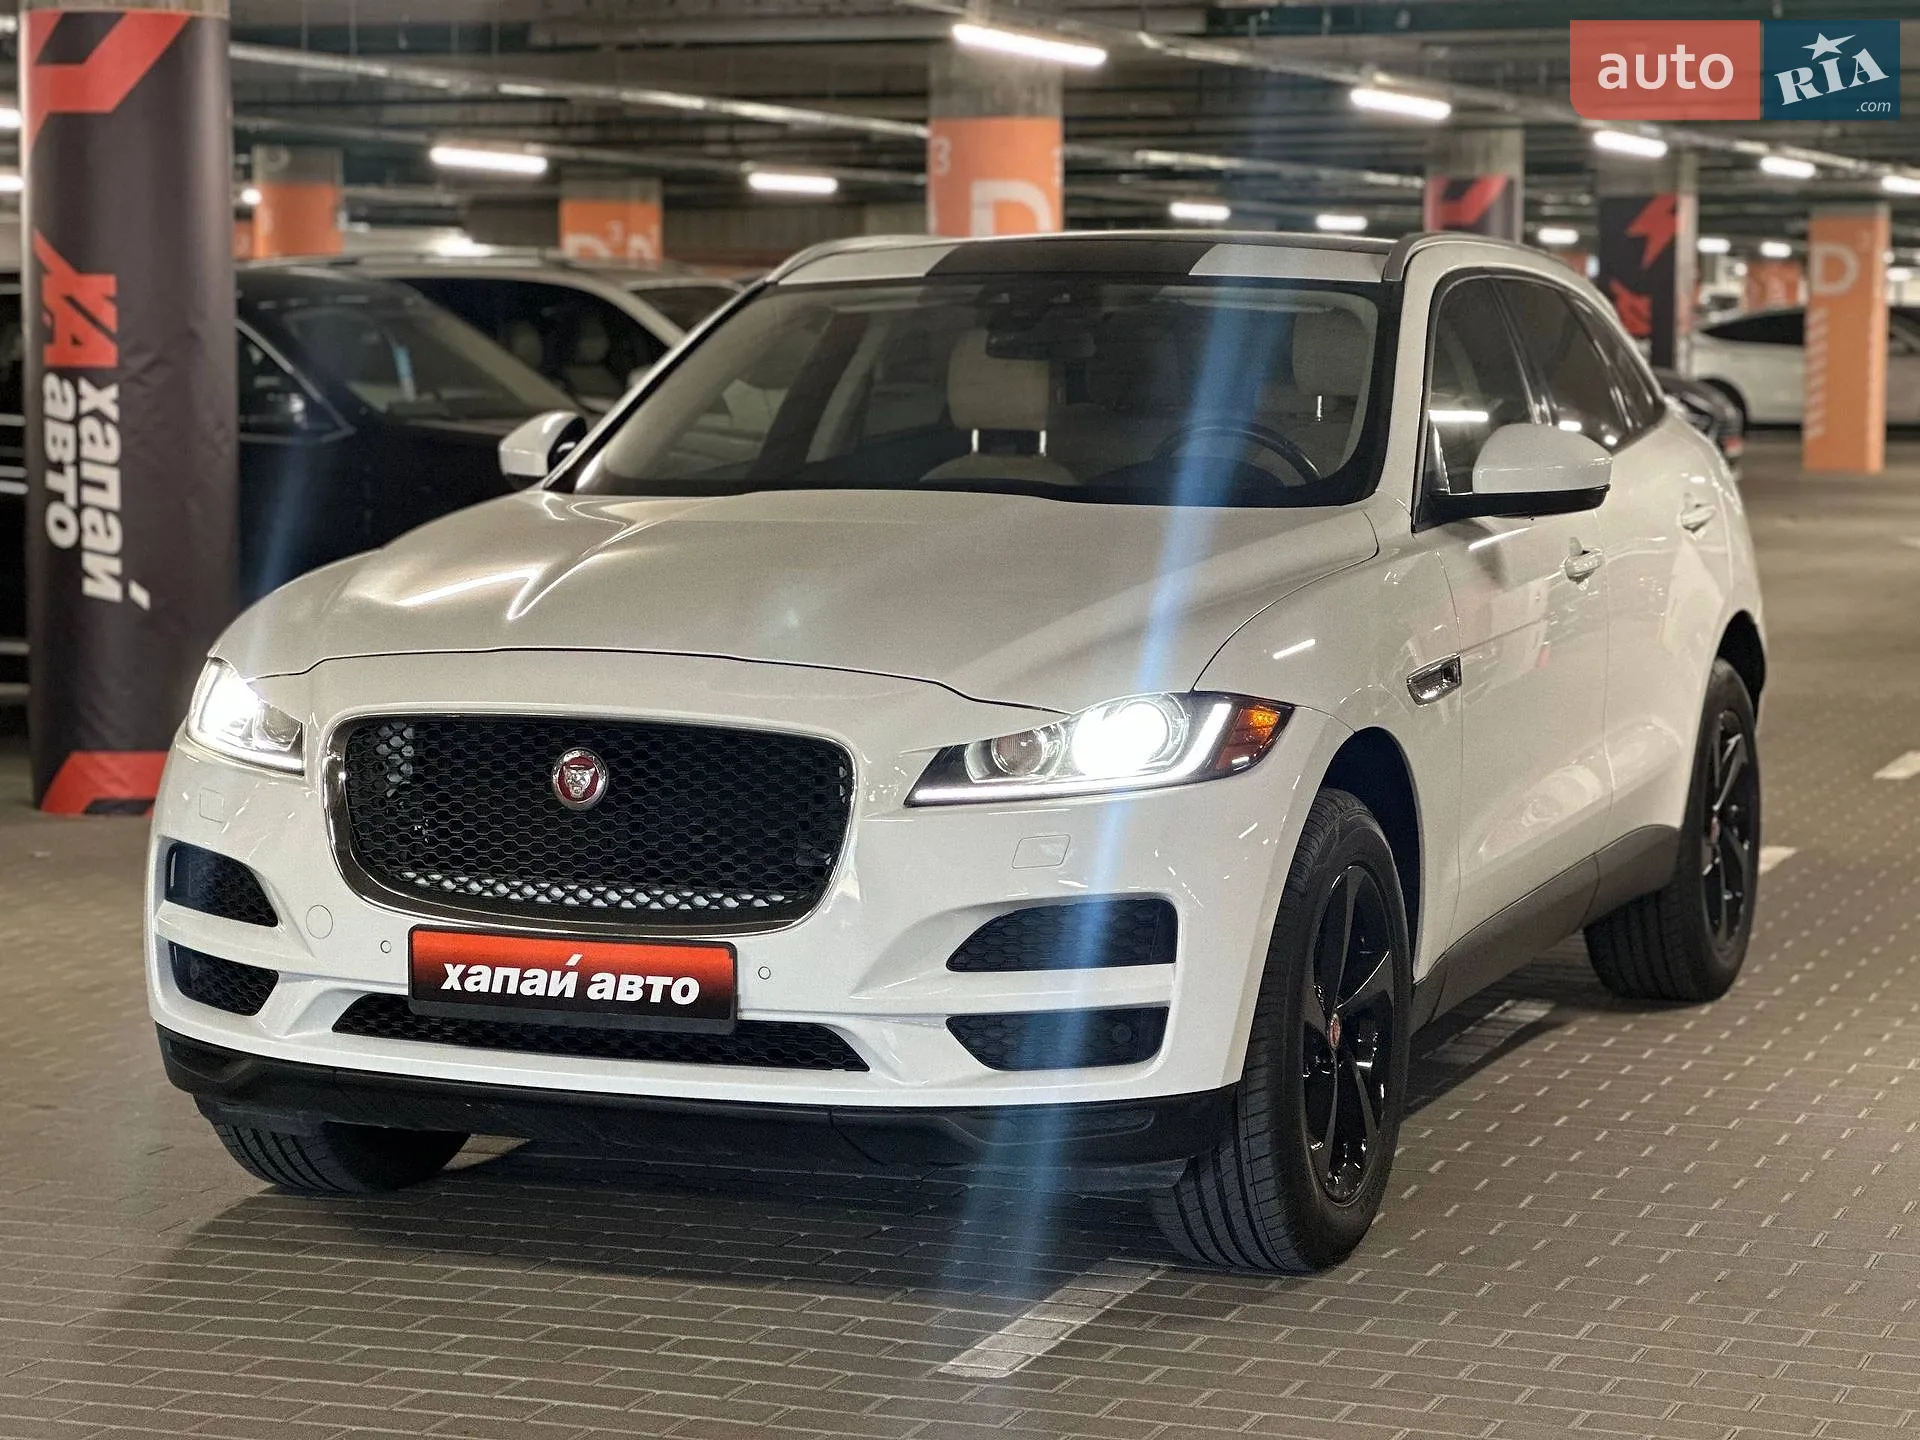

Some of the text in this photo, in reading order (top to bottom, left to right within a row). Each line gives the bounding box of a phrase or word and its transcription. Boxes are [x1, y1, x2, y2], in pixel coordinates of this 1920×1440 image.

[43, 372, 79, 550] авто
[79, 376, 151, 611] хапай
[440, 953, 700, 1006] хапай авто
